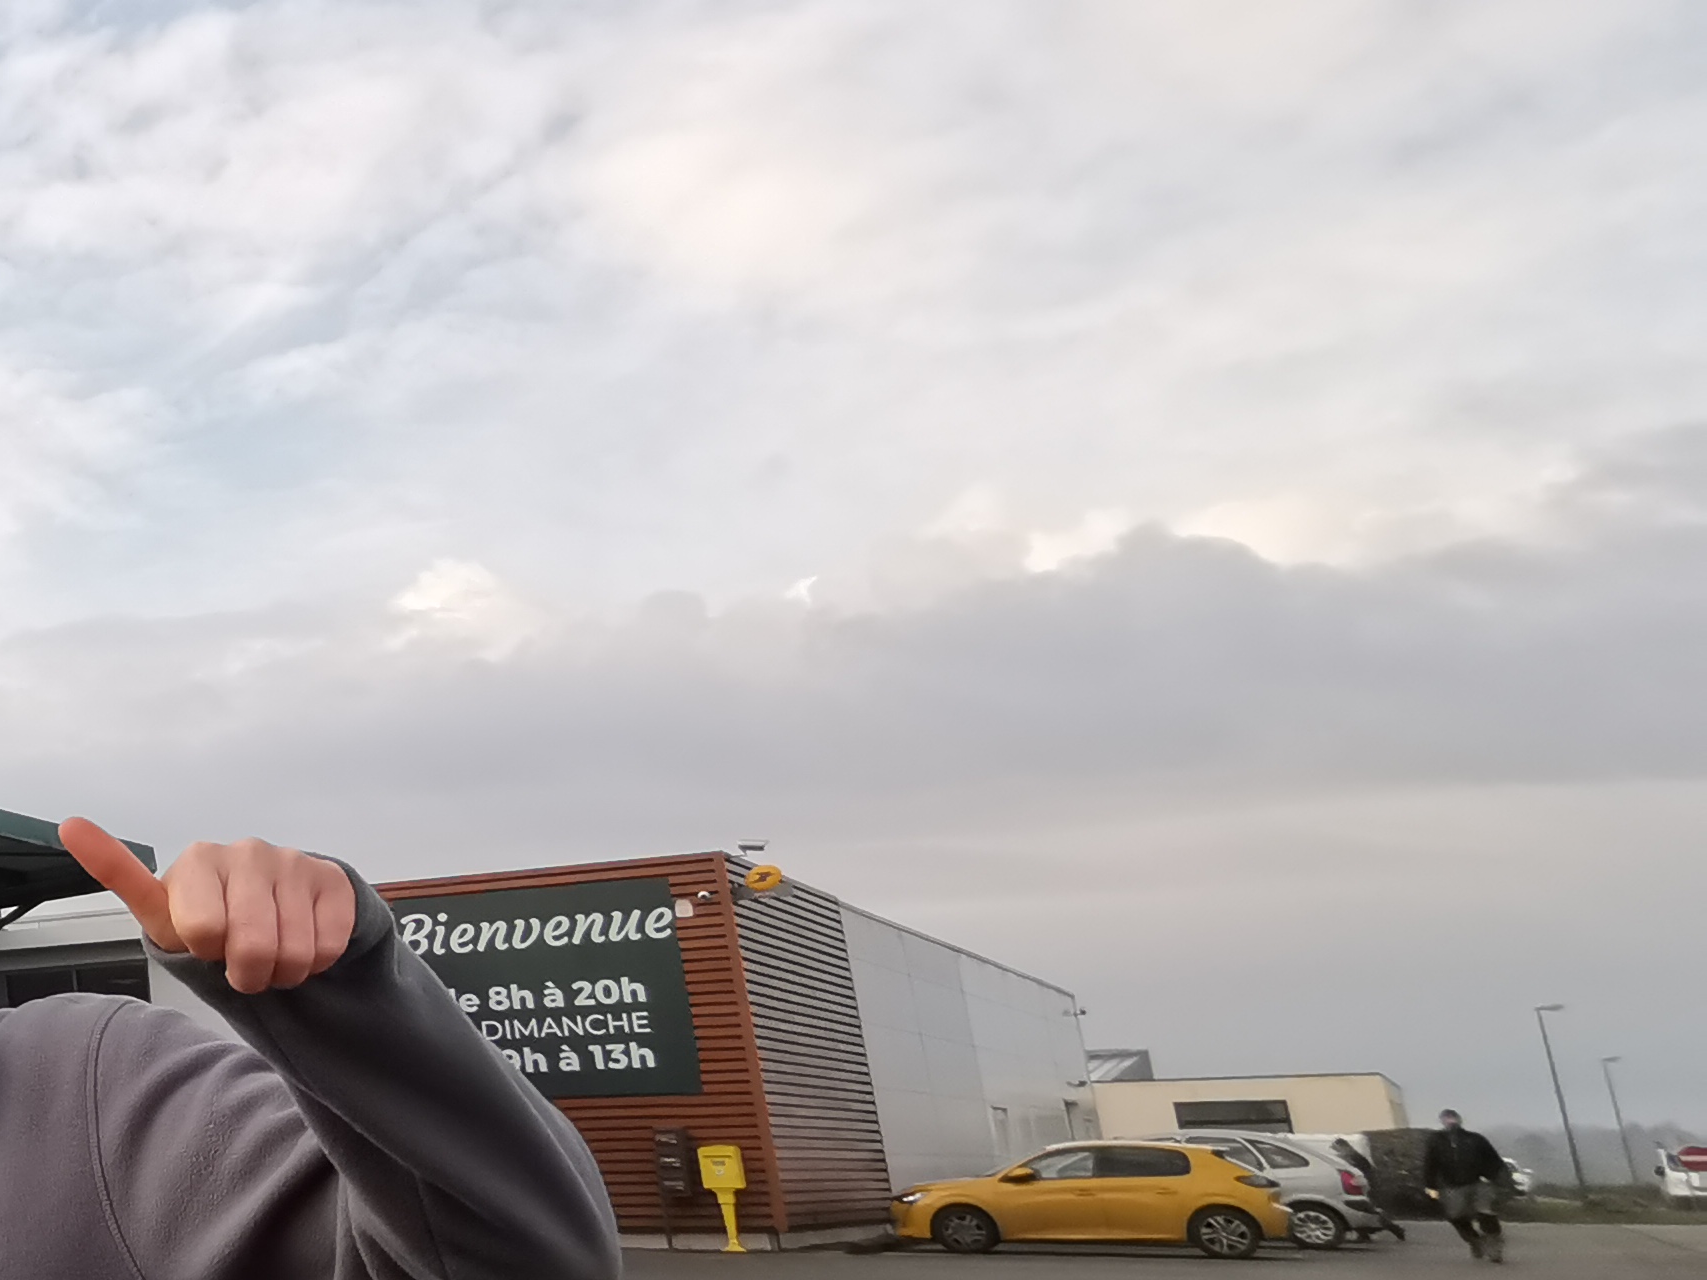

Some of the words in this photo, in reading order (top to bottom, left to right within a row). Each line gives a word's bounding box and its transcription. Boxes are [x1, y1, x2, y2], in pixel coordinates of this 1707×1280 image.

[399, 906, 673, 956] Bienvenue
[488, 984, 535, 1012] 8h
[543, 980, 565, 1008] à
[571, 976, 648, 1006] 20h
[481, 1011, 653, 1041] DIMANCHE
[558, 1044, 581, 1072] à
[587, 1041, 657, 1070] 13h
